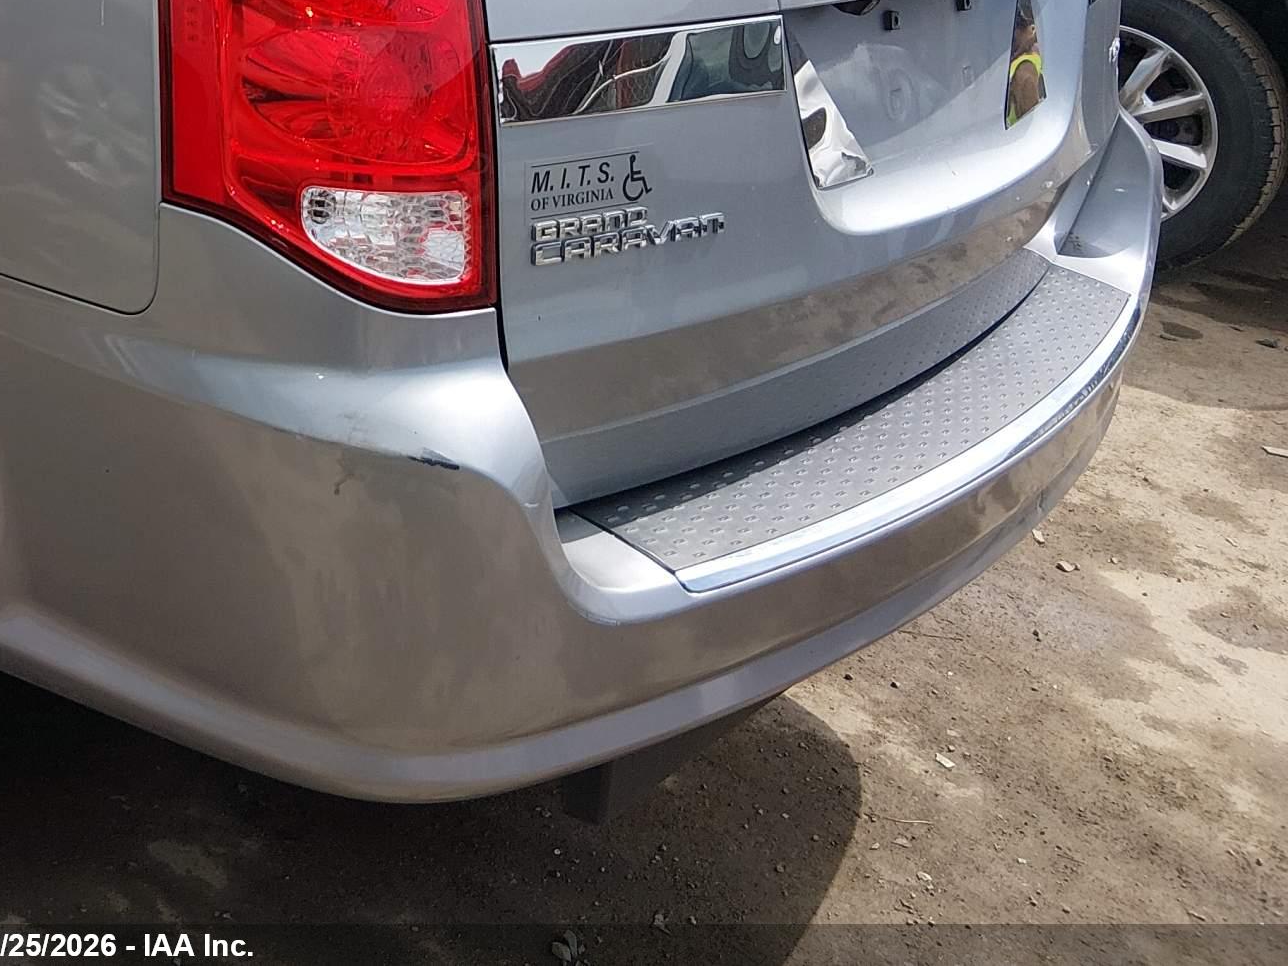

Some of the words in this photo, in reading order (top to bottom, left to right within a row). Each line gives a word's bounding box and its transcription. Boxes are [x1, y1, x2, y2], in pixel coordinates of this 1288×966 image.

[531, 198, 550, 212] OF
[552, 187, 615, 208] VIRGINIA
[530, 206, 649, 242] GRAND
[530, 212, 726, 266] CARAVAN
